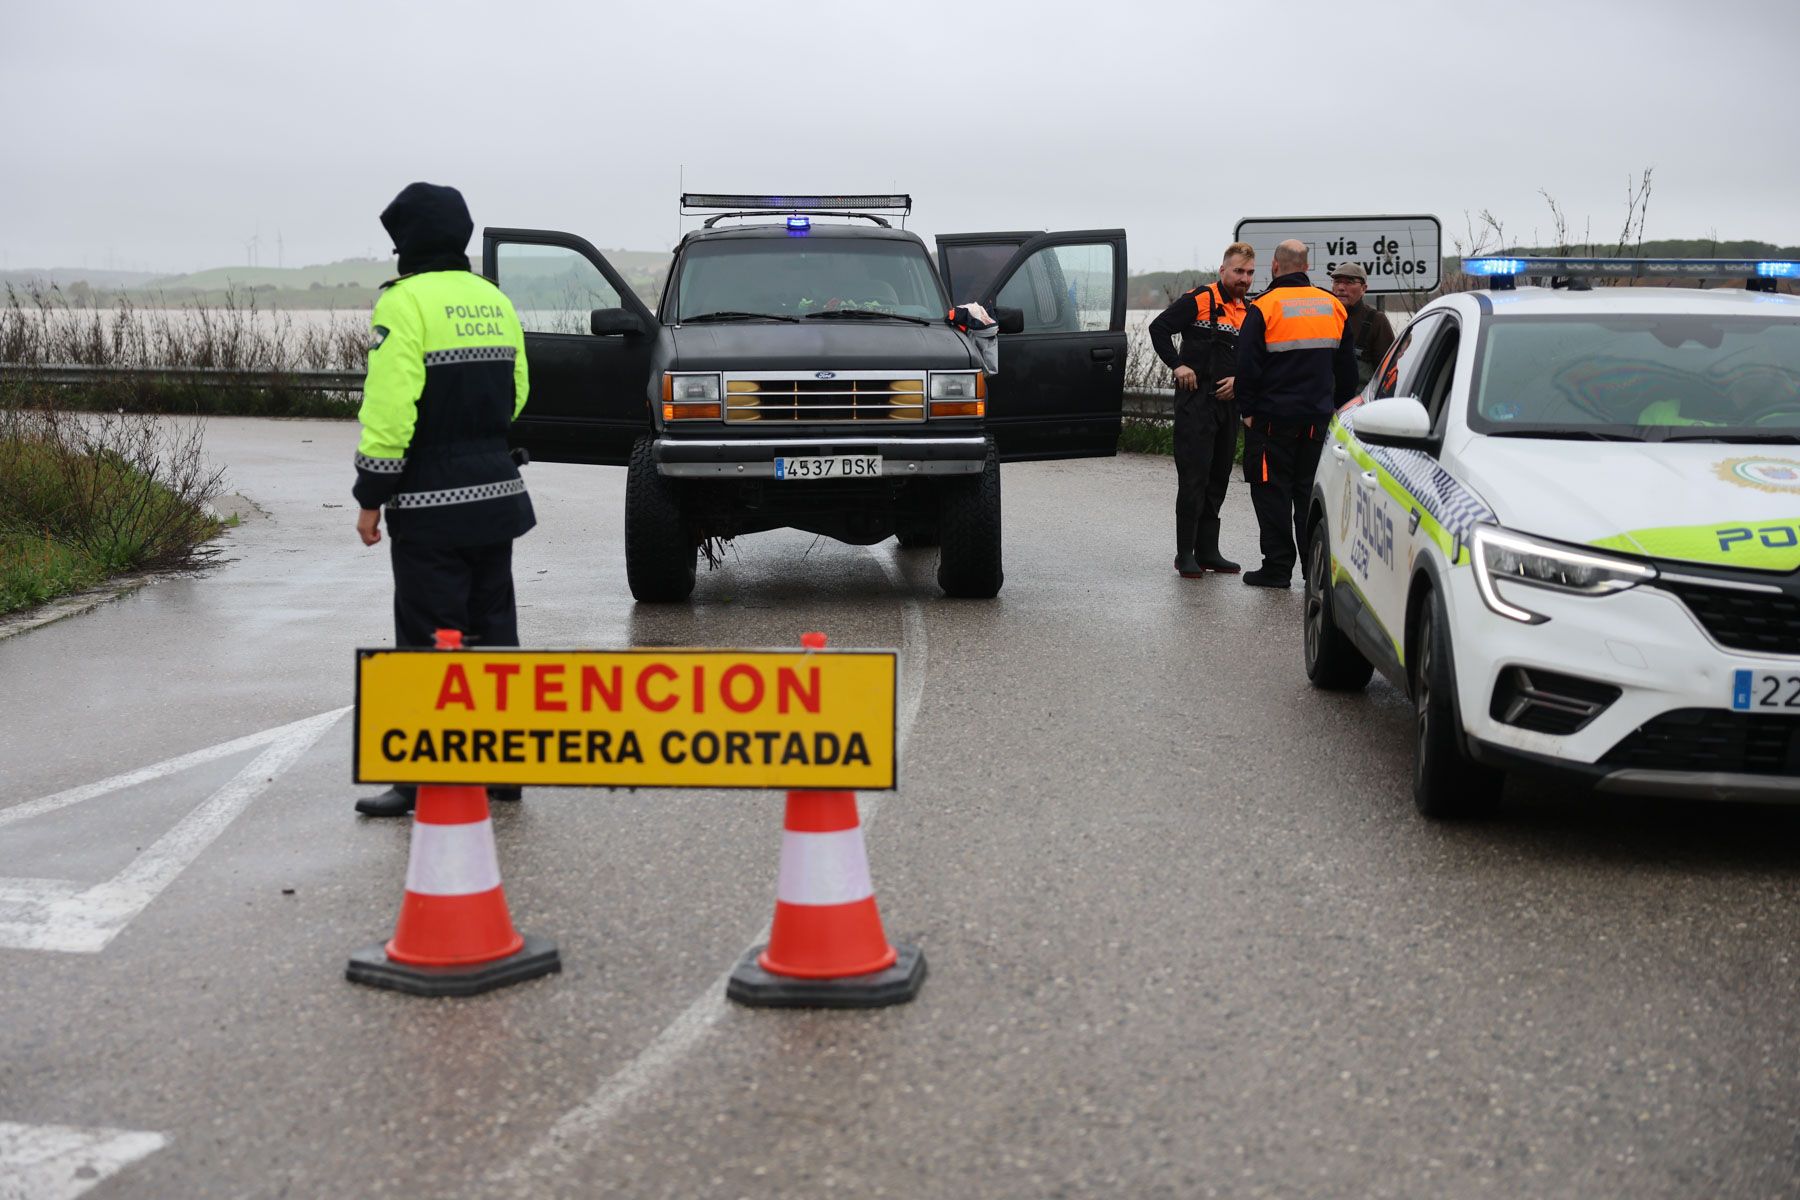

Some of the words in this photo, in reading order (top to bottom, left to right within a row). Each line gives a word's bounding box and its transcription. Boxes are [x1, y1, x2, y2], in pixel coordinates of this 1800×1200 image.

[1326, 237, 1357, 255] vía
[1373, 235, 1398, 254] de
[1326, 256, 1426, 275] svicios
[445, 305, 504, 318] POLICIA
[456, 322, 504, 336] LOCAL
[788, 460, 834, 477] 4537
[842, 459, 877, 475] DSK
[1716, 525, 1800, 551] PO
[435, 663, 821, 714] ATENCION
[381, 729, 644, 764] CARRETERA
[660, 730, 872, 766] CORTADA
